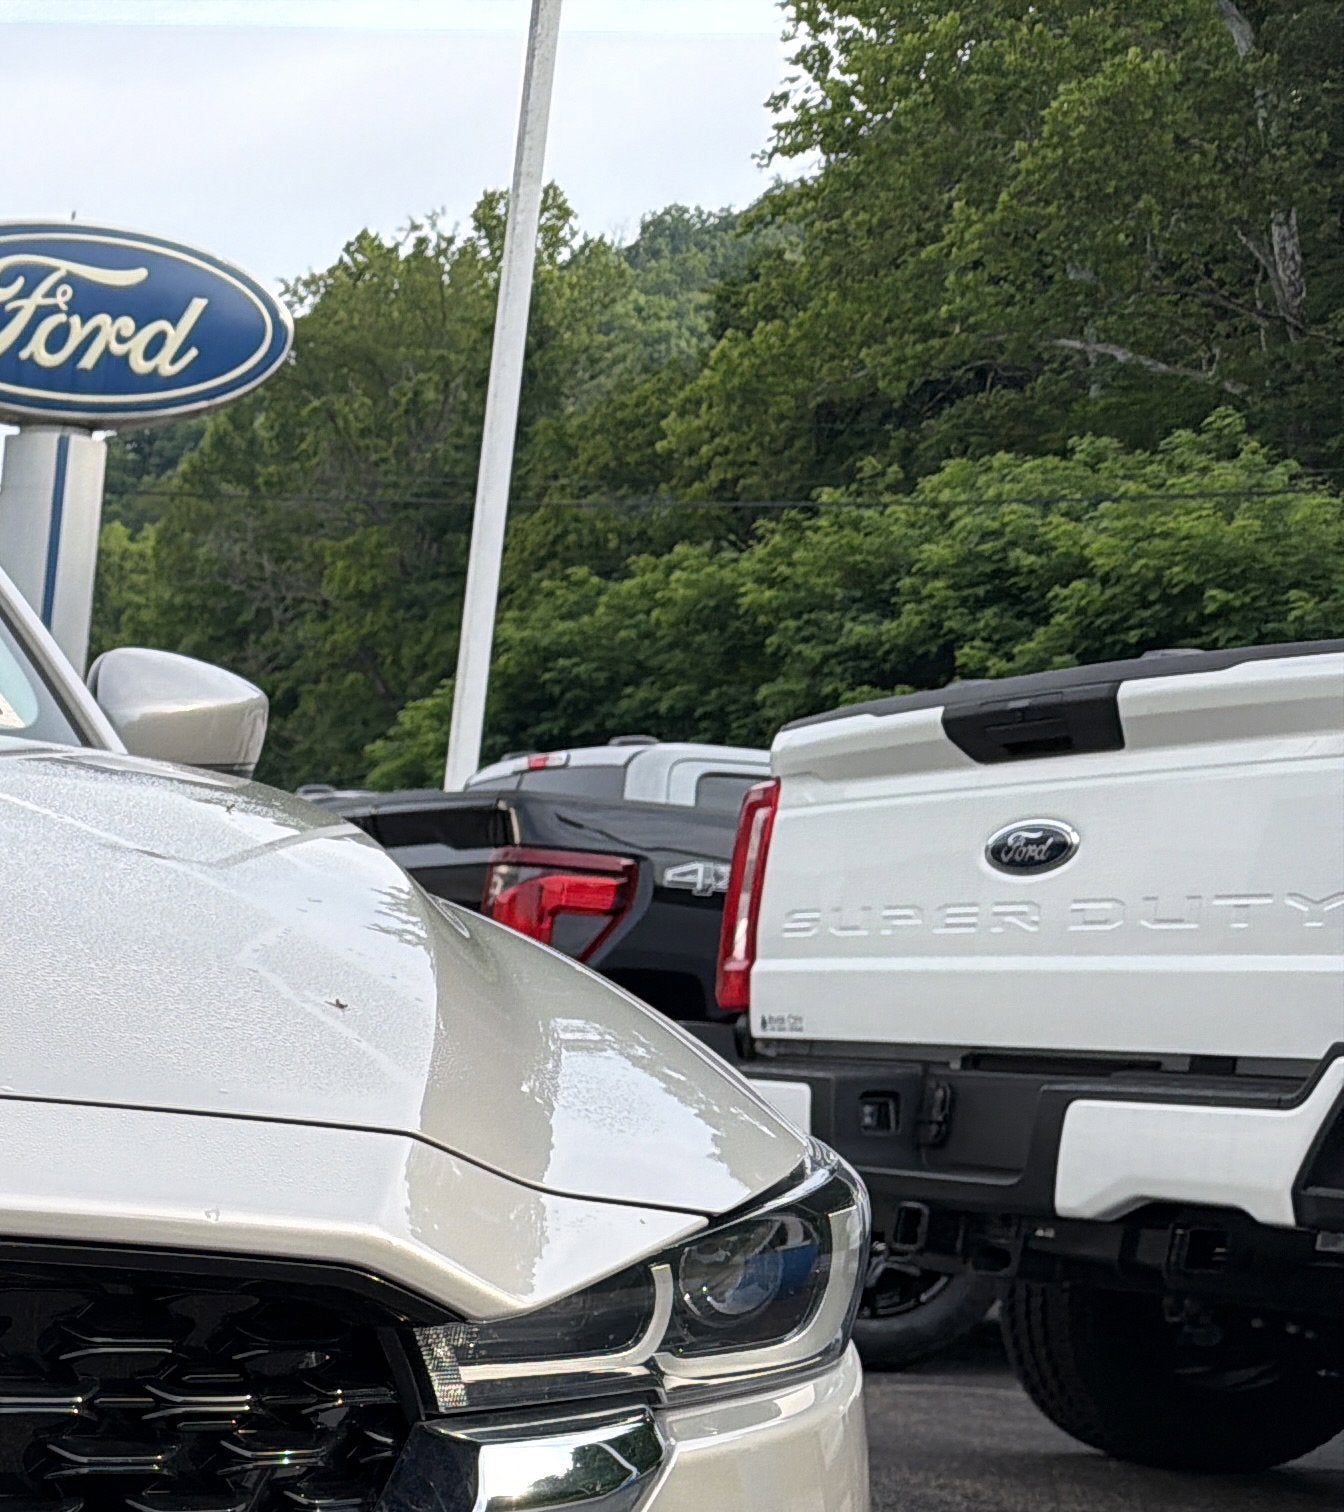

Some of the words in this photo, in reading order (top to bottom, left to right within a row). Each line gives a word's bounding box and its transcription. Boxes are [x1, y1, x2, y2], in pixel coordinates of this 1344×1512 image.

[1001, 830, 1054, 862] Ford
[781, 901, 1041, 938] SUPER
[1067, 892, 1344, 931] DUTY
